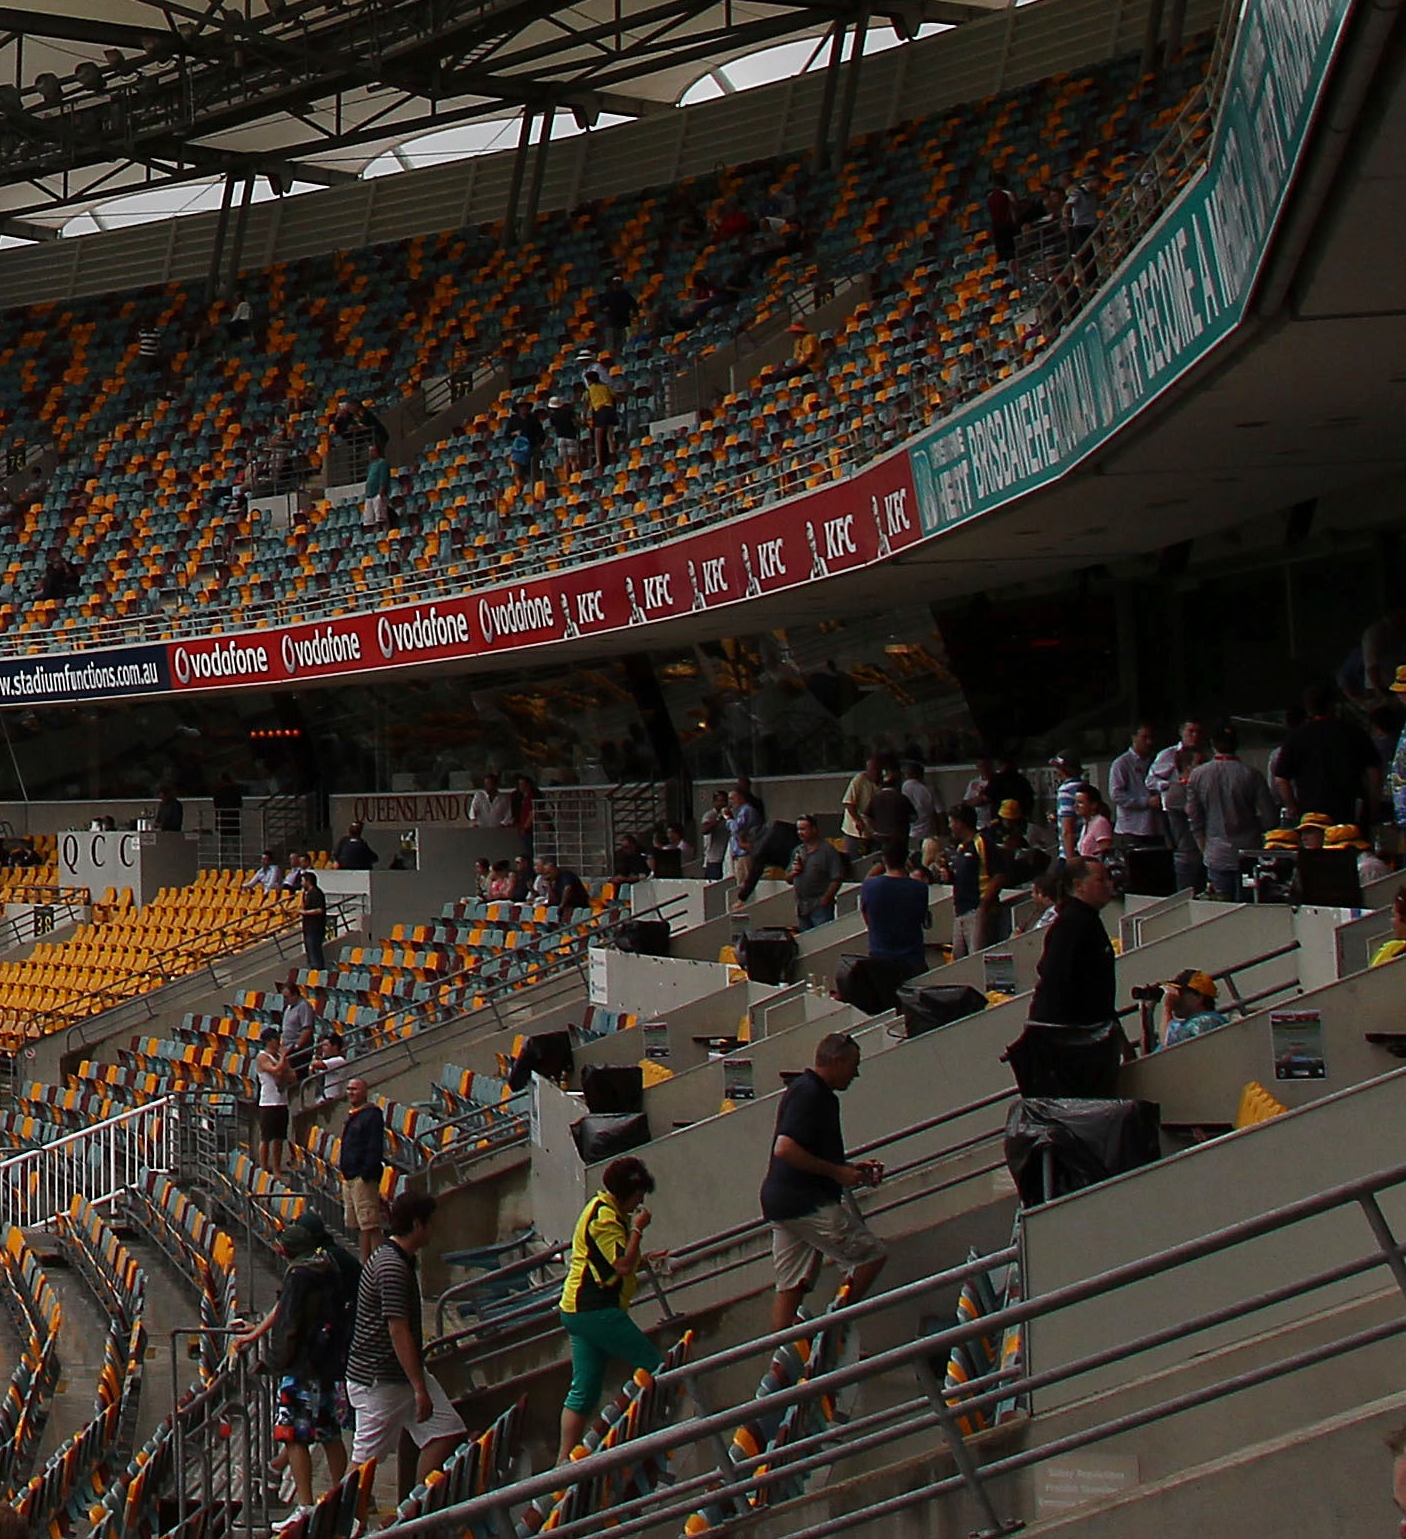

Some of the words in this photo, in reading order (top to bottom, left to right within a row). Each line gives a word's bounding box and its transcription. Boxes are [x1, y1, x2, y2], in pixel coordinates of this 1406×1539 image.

[1131, 227, 1204, 379] BECOME
[1192, 213, 1219, 323] A
[884, 489, 910, 536] KFC
[824, 515, 857, 559] KFC
[703, 557, 728, 595] KFC
[758, 538, 786, 579] KFC
[577, 591, 604, 624] KFC
[644, 574, 673, 609] KFC
[394, 609, 468, 650] vodafone
[491, 590, 554, 635] vodafone
[190, 641, 268, 677] vodafone
[294, 627, 360, 667] vodafone
[354, 795, 459, 822] QUEENSLAND
[63, 834, 78, 875] Q
[92, 834, 106, 867] C
[120, 834, 135, 867] C
[37, 915, 52, 935] 38
